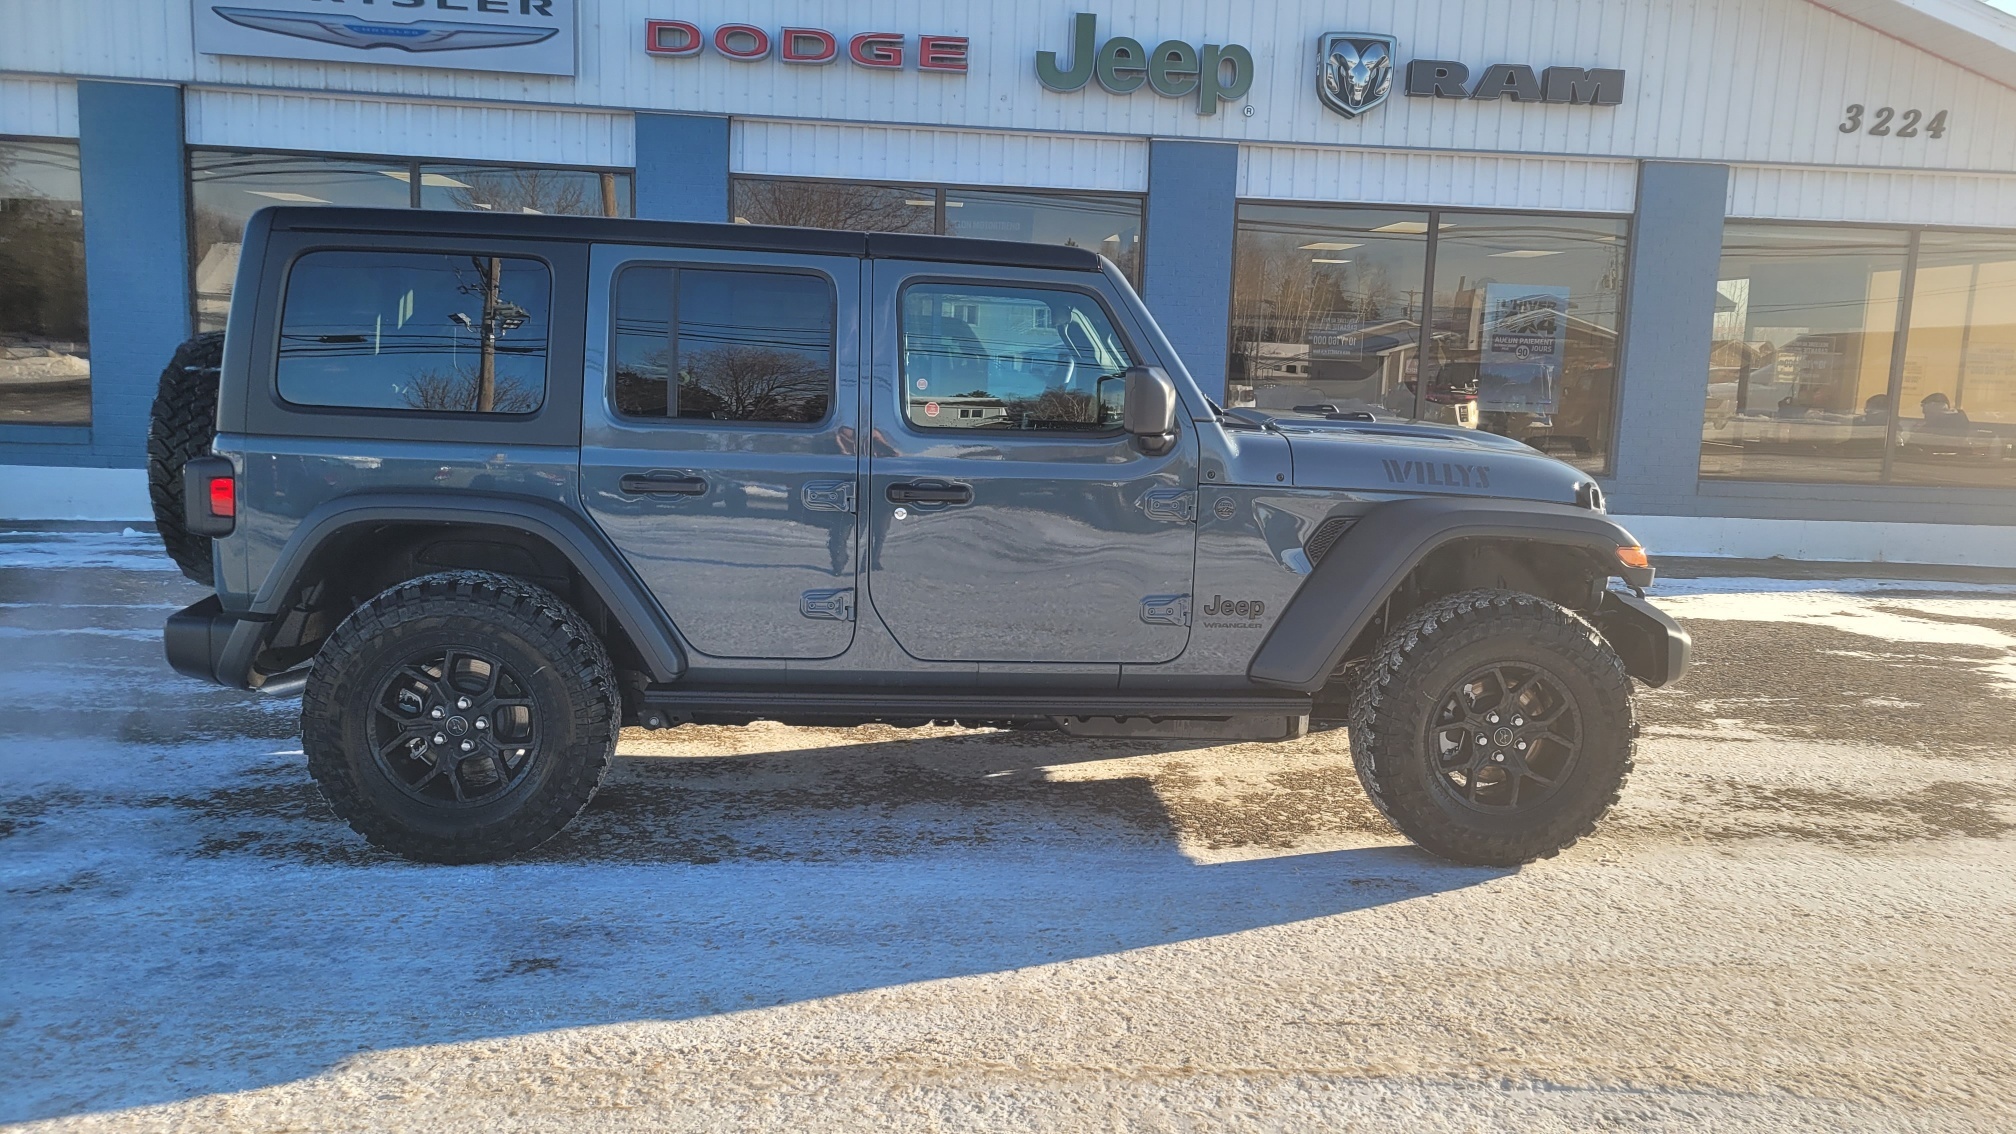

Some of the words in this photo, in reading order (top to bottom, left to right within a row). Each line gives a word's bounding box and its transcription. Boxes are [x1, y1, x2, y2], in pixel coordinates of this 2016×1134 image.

[645, 18, 970, 74] DODGE
[1034, 12, 1255, 116] Jeep
[1405, 59, 1626, 106] RAM
[1838, 103, 1949, 139] 3224
[1382, 459, 1490, 489] WILLYS
[1203, 594, 1265, 620] Jeep
[1203, 621, 1263, 629] WRANGLER
